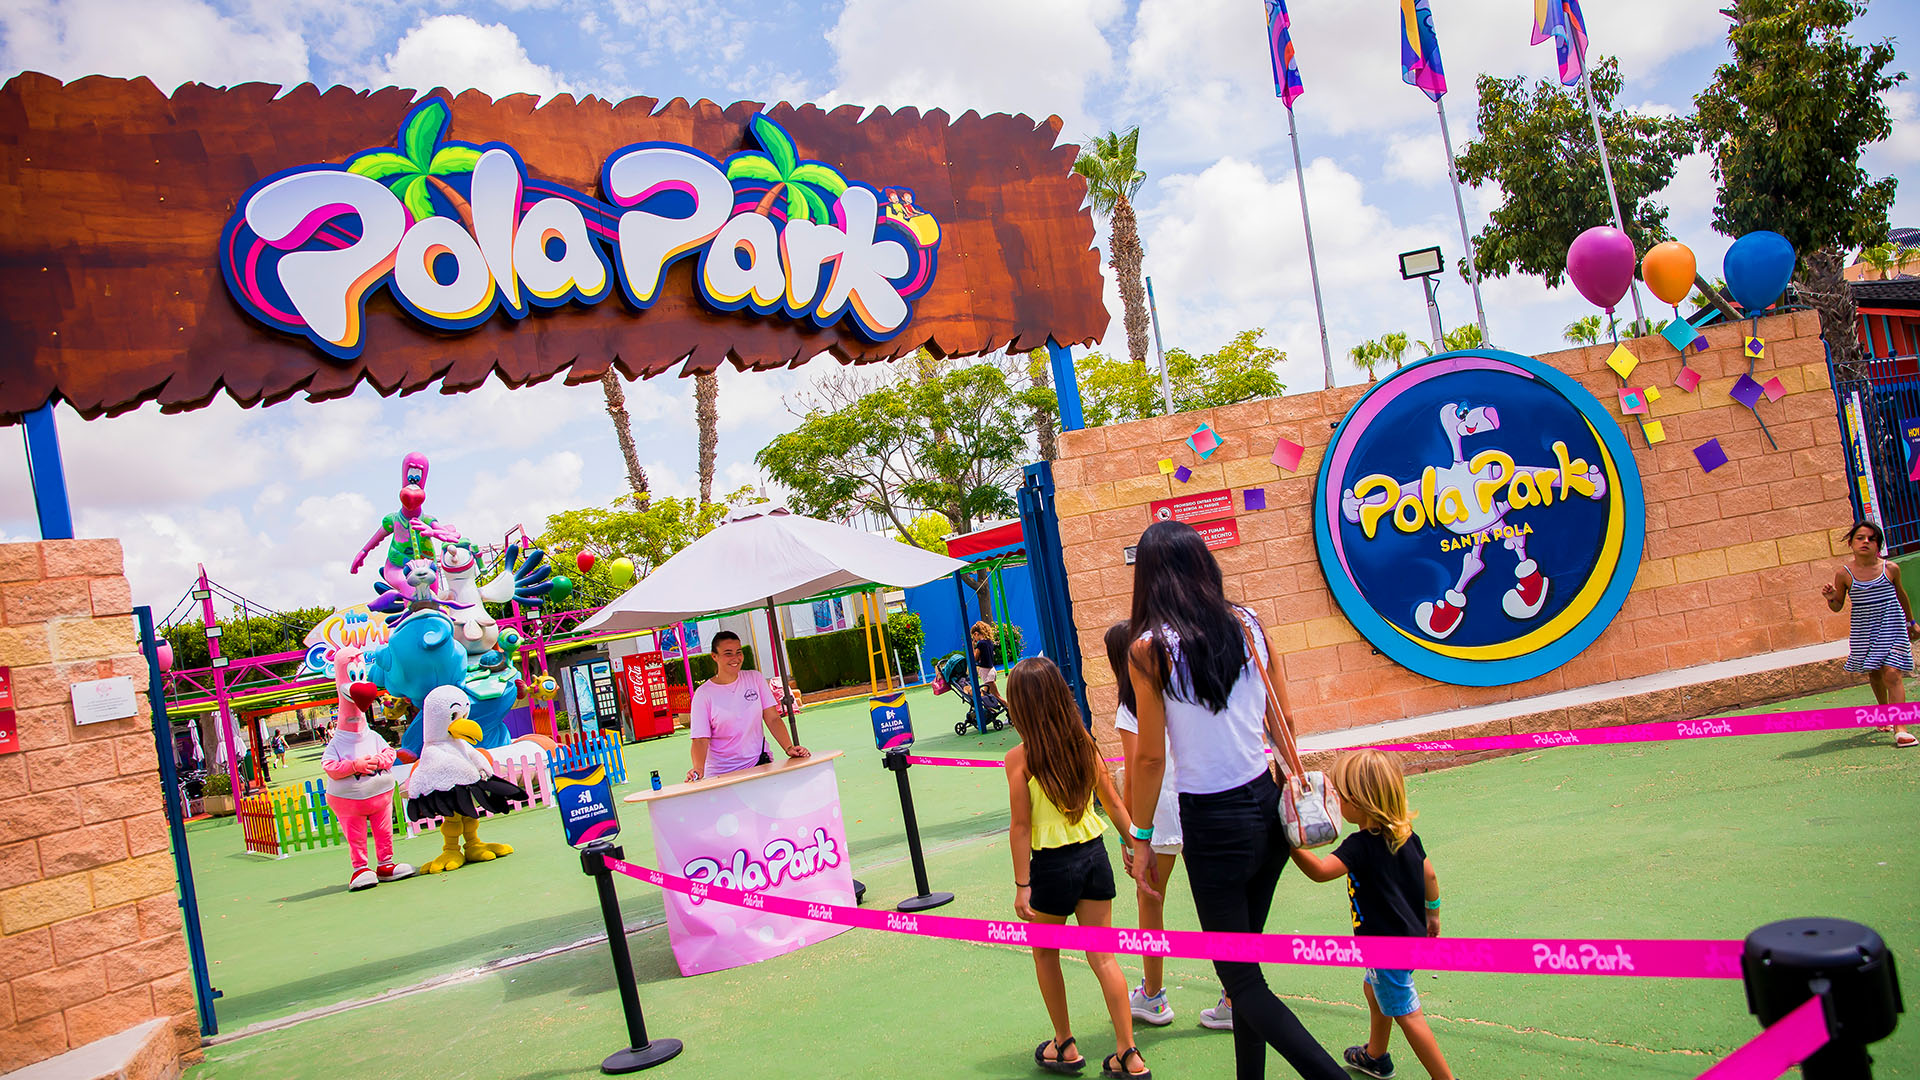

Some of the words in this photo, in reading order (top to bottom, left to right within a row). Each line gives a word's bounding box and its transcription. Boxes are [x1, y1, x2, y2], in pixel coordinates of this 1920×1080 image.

[246, 149, 607, 347] Pola
[610, 148, 910, 333] Park
[1354, 466, 1469, 538] Pola
[1470, 441, 1596, 514] Park
[1208, 526, 1225, 534] FUMAR
[1211, 531, 1232, 539] RECINTO
[1440, 532, 1492, 552] SANTA
[1494, 522, 1534, 539] POLA
[345, 609, 368, 624] the
[881, 719, 903, 729] SALIDA
[1855, 708, 1887, 724] Pola
[1887, 706, 1920, 722] Park
[1677, 722, 1703, 736] Pola
[1702, 720, 1732, 734] Park
[1533, 734, 1554, 745] Pola
[1554, 732, 1579, 744] Park
[570, 803, 604, 817] ENTRADA
[764, 828, 838, 884] Park
[808, 904, 820, 917] Pola
[819, 905, 832, 920] Park
[887, 913, 901, 929] Pola
[901, 915, 918, 931] Park
[988, 922, 1006, 940] Pola
[1006, 924, 1027, 942] Park
[1118, 931, 1142, 950] Pola
[1142, 933, 1171, 953] Park
[1292, 938, 1325, 961] Pola
[1325, 939, 1363, 963] Park
[1533, 943, 1579, 969] Pola
[1580, 944, 1635, 971] Park
